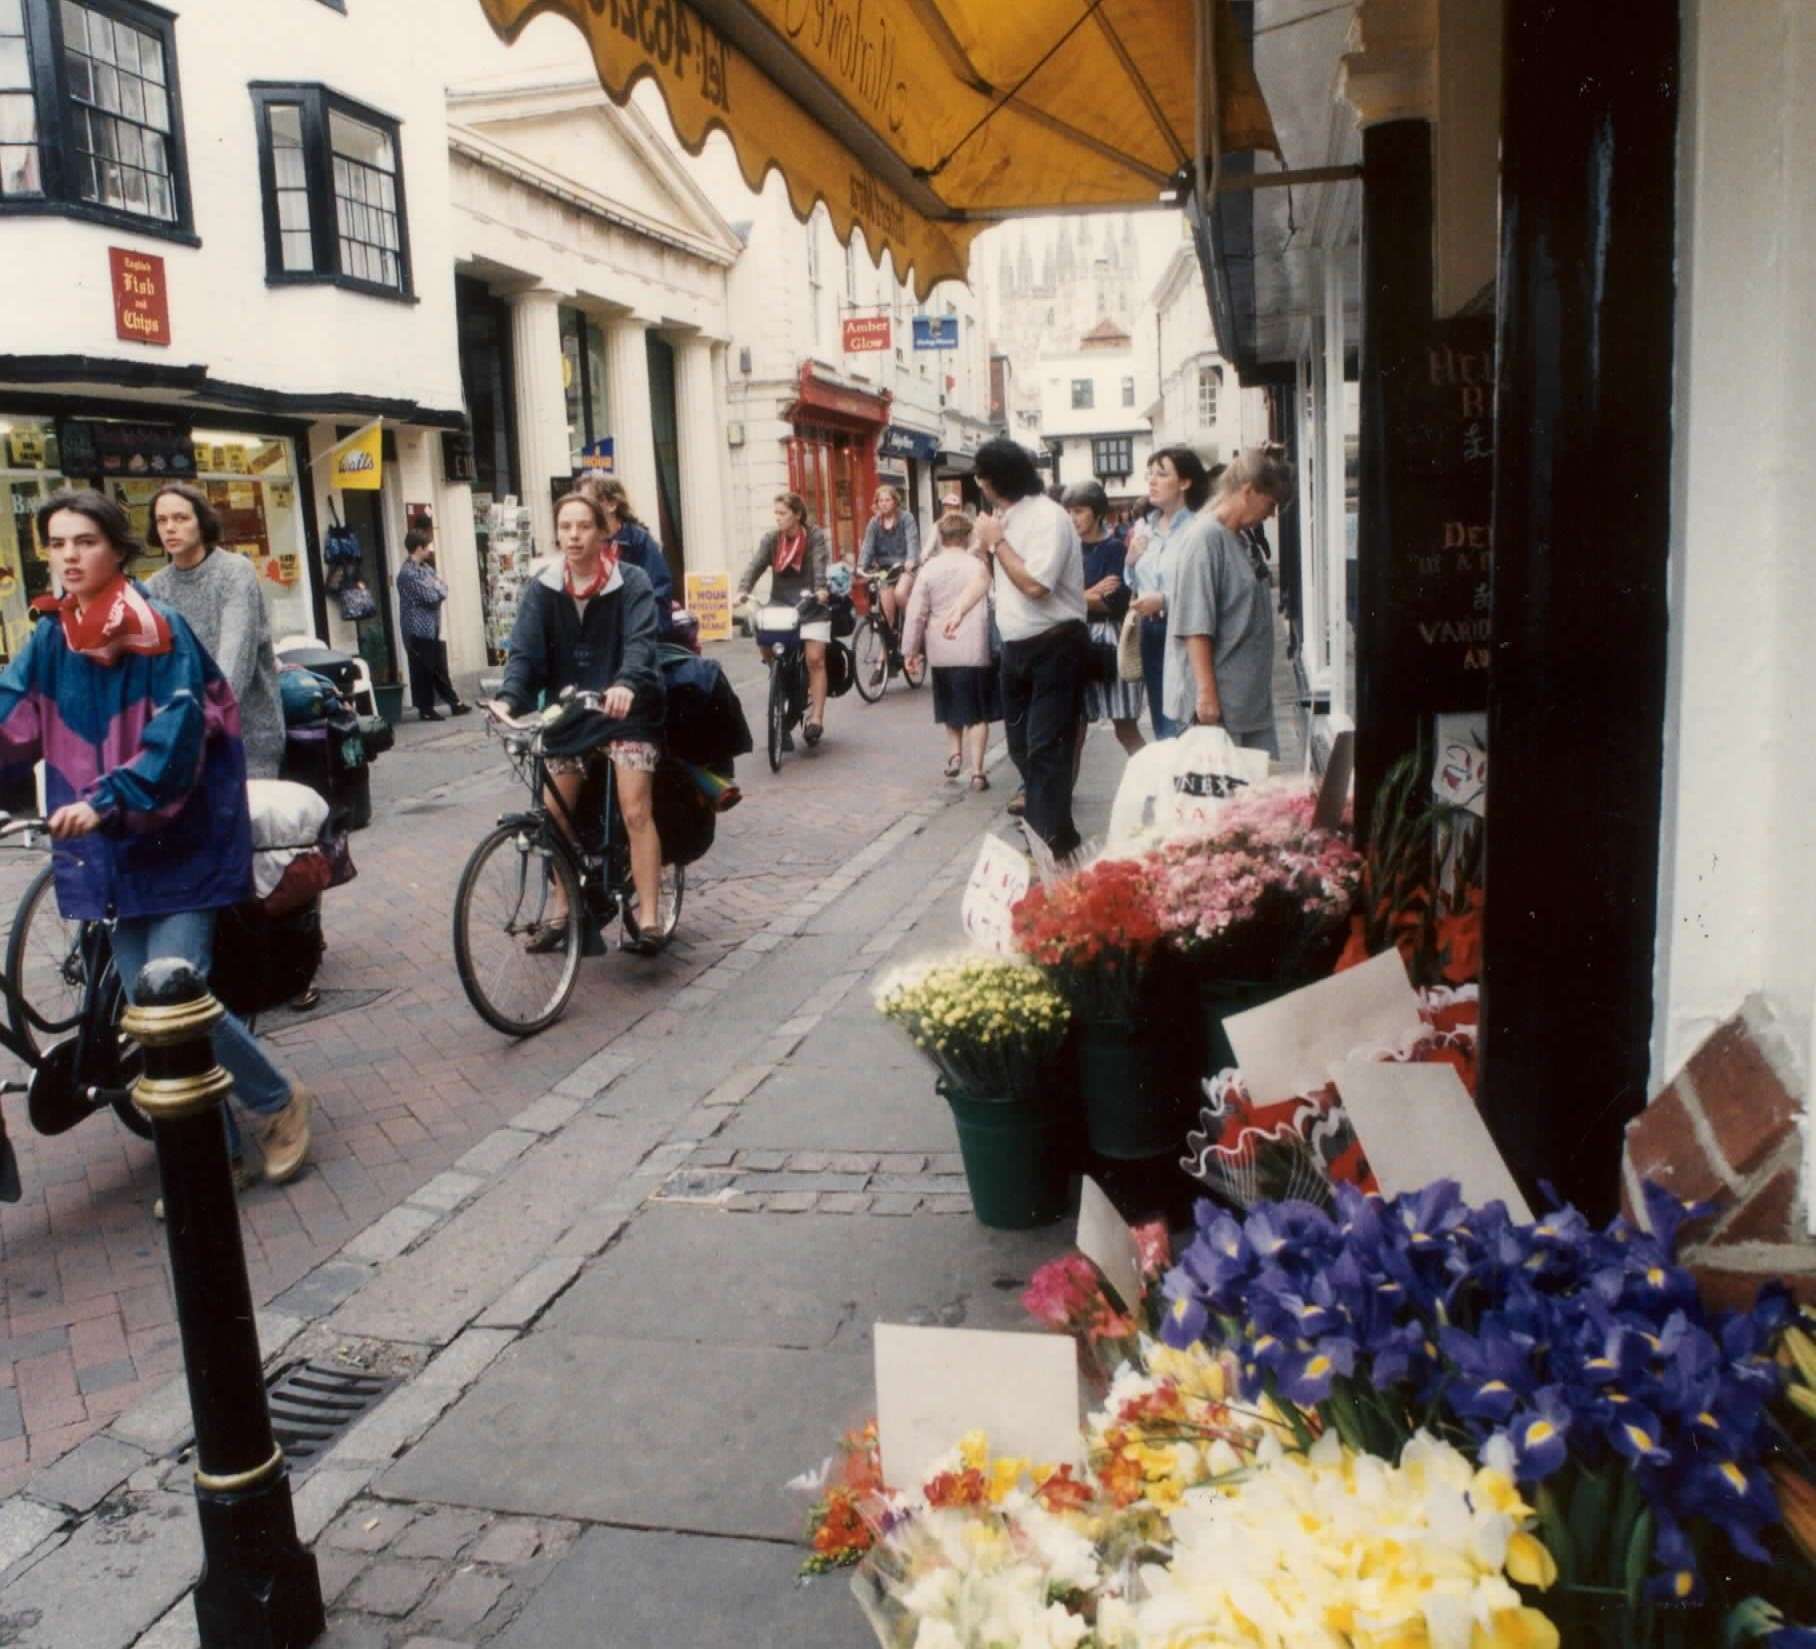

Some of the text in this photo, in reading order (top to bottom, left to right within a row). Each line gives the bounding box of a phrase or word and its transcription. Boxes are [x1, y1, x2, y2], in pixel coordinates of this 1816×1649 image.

[122, 272, 155, 295] Fish
[123, 309, 160, 336] Chips
[846, 321, 889, 334] Amber
[850, 338, 883, 350] Glow
[697, 591, 728, 601] HOUR
